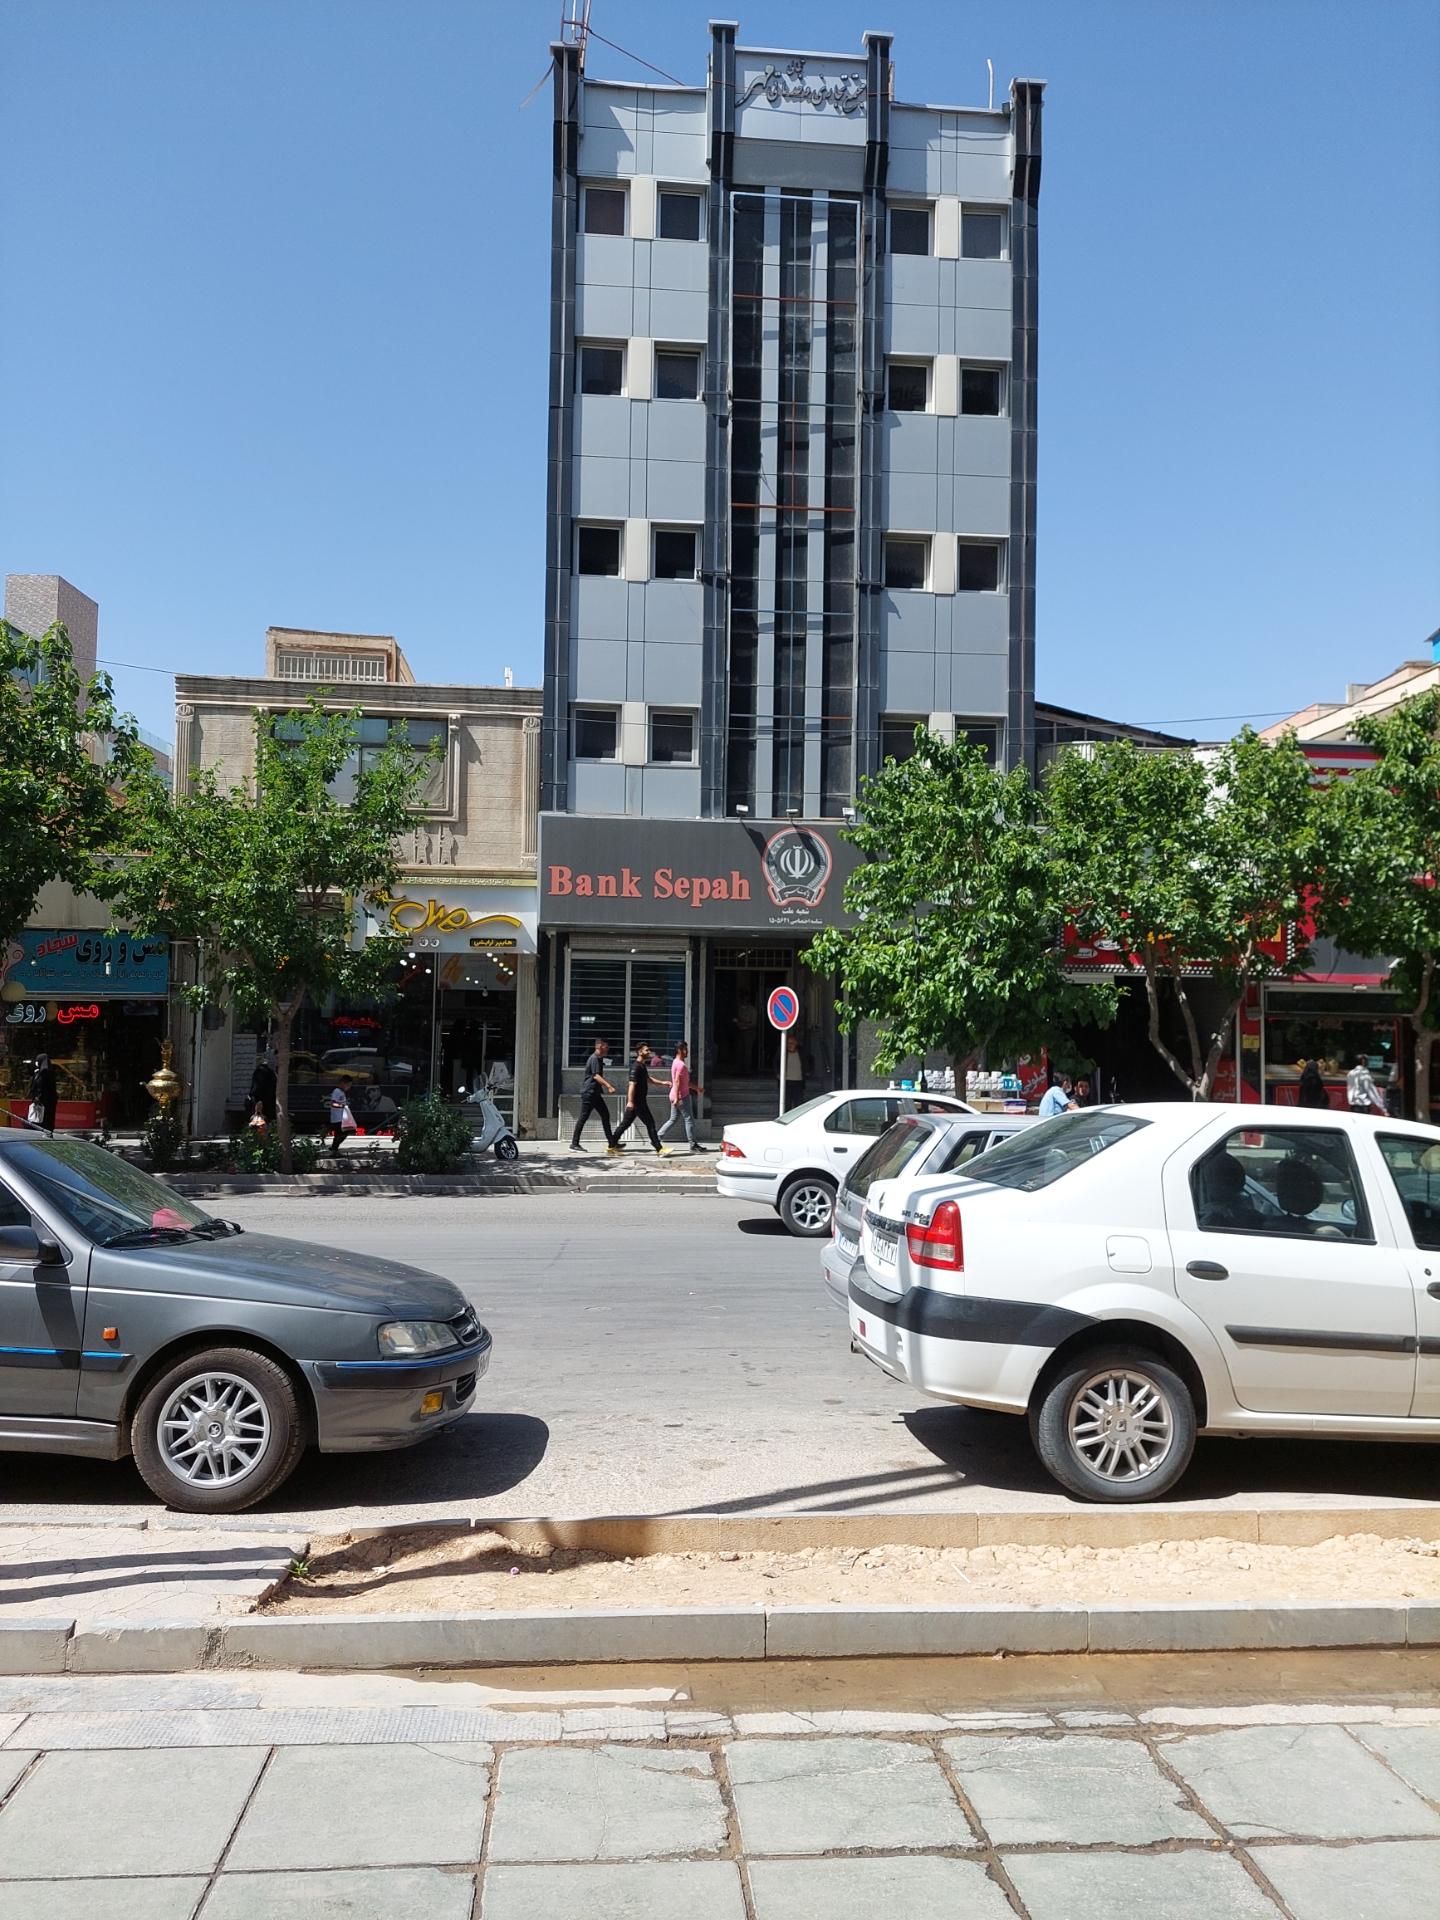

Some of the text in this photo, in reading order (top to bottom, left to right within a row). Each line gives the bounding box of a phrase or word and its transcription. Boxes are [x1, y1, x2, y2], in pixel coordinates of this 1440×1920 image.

[548, 865, 752, 908] Bank Sepah
[795, 907, 810, 916] شعبه
[36, 934, 79, 957] سجاد
[75, 938, 113, 963] روی
[57, 1004, 99, 1024] مس
